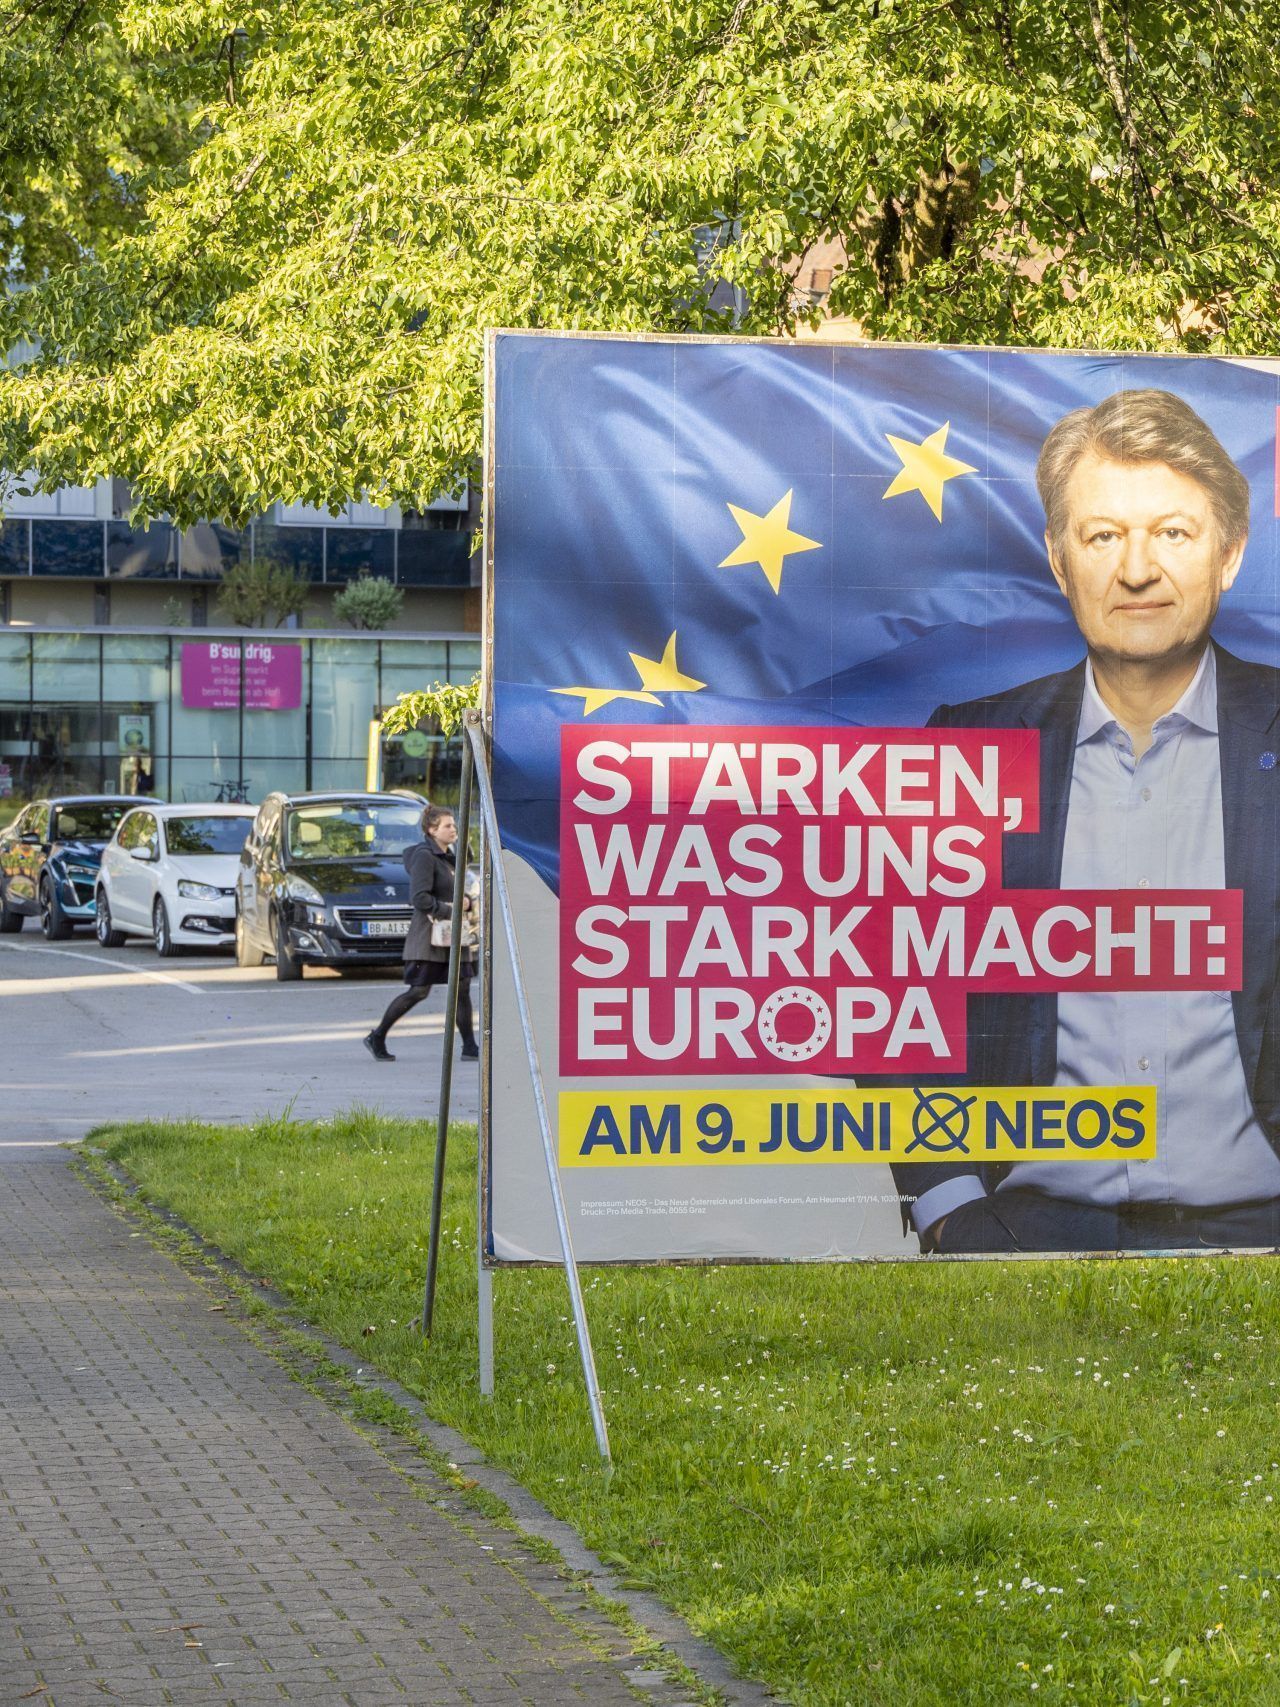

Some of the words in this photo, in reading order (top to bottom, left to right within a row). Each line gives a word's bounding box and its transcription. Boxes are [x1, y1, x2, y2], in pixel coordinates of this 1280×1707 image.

[223, 664, 269, 675] Supemarkt
[572, 741, 1023, 832] STÄRKEN,
[572, 825, 787, 897] WAS
[803, 825, 986, 898] UNS
[572, 905, 873, 979] STARK
[893, 905, 1226, 977] MACHT:
[577, 985, 951, 1062] EUROPA
[579, 1104, 681, 1156] AM
[695, 1103, 746, 1155] 9.
[758, 1101, 891, 1154] JUNI
[984, 1099, 1145, 1150] NEOS
[580, 1200, 624, 1208] Impressum:
[625, 1199, 647, 1207] NEOS
[690, 1197, 727, 1206] Österreich
[728, 1197, 742, 1205] und
[744, 1197, 778, 1205] Liberales
[899, 1194, 918, 1202] Wien
[581, 1208, 605, 1216] Druck:
[620, 1207, 643, 1215] Media
[689, 1206, 706, 1214] Graz
